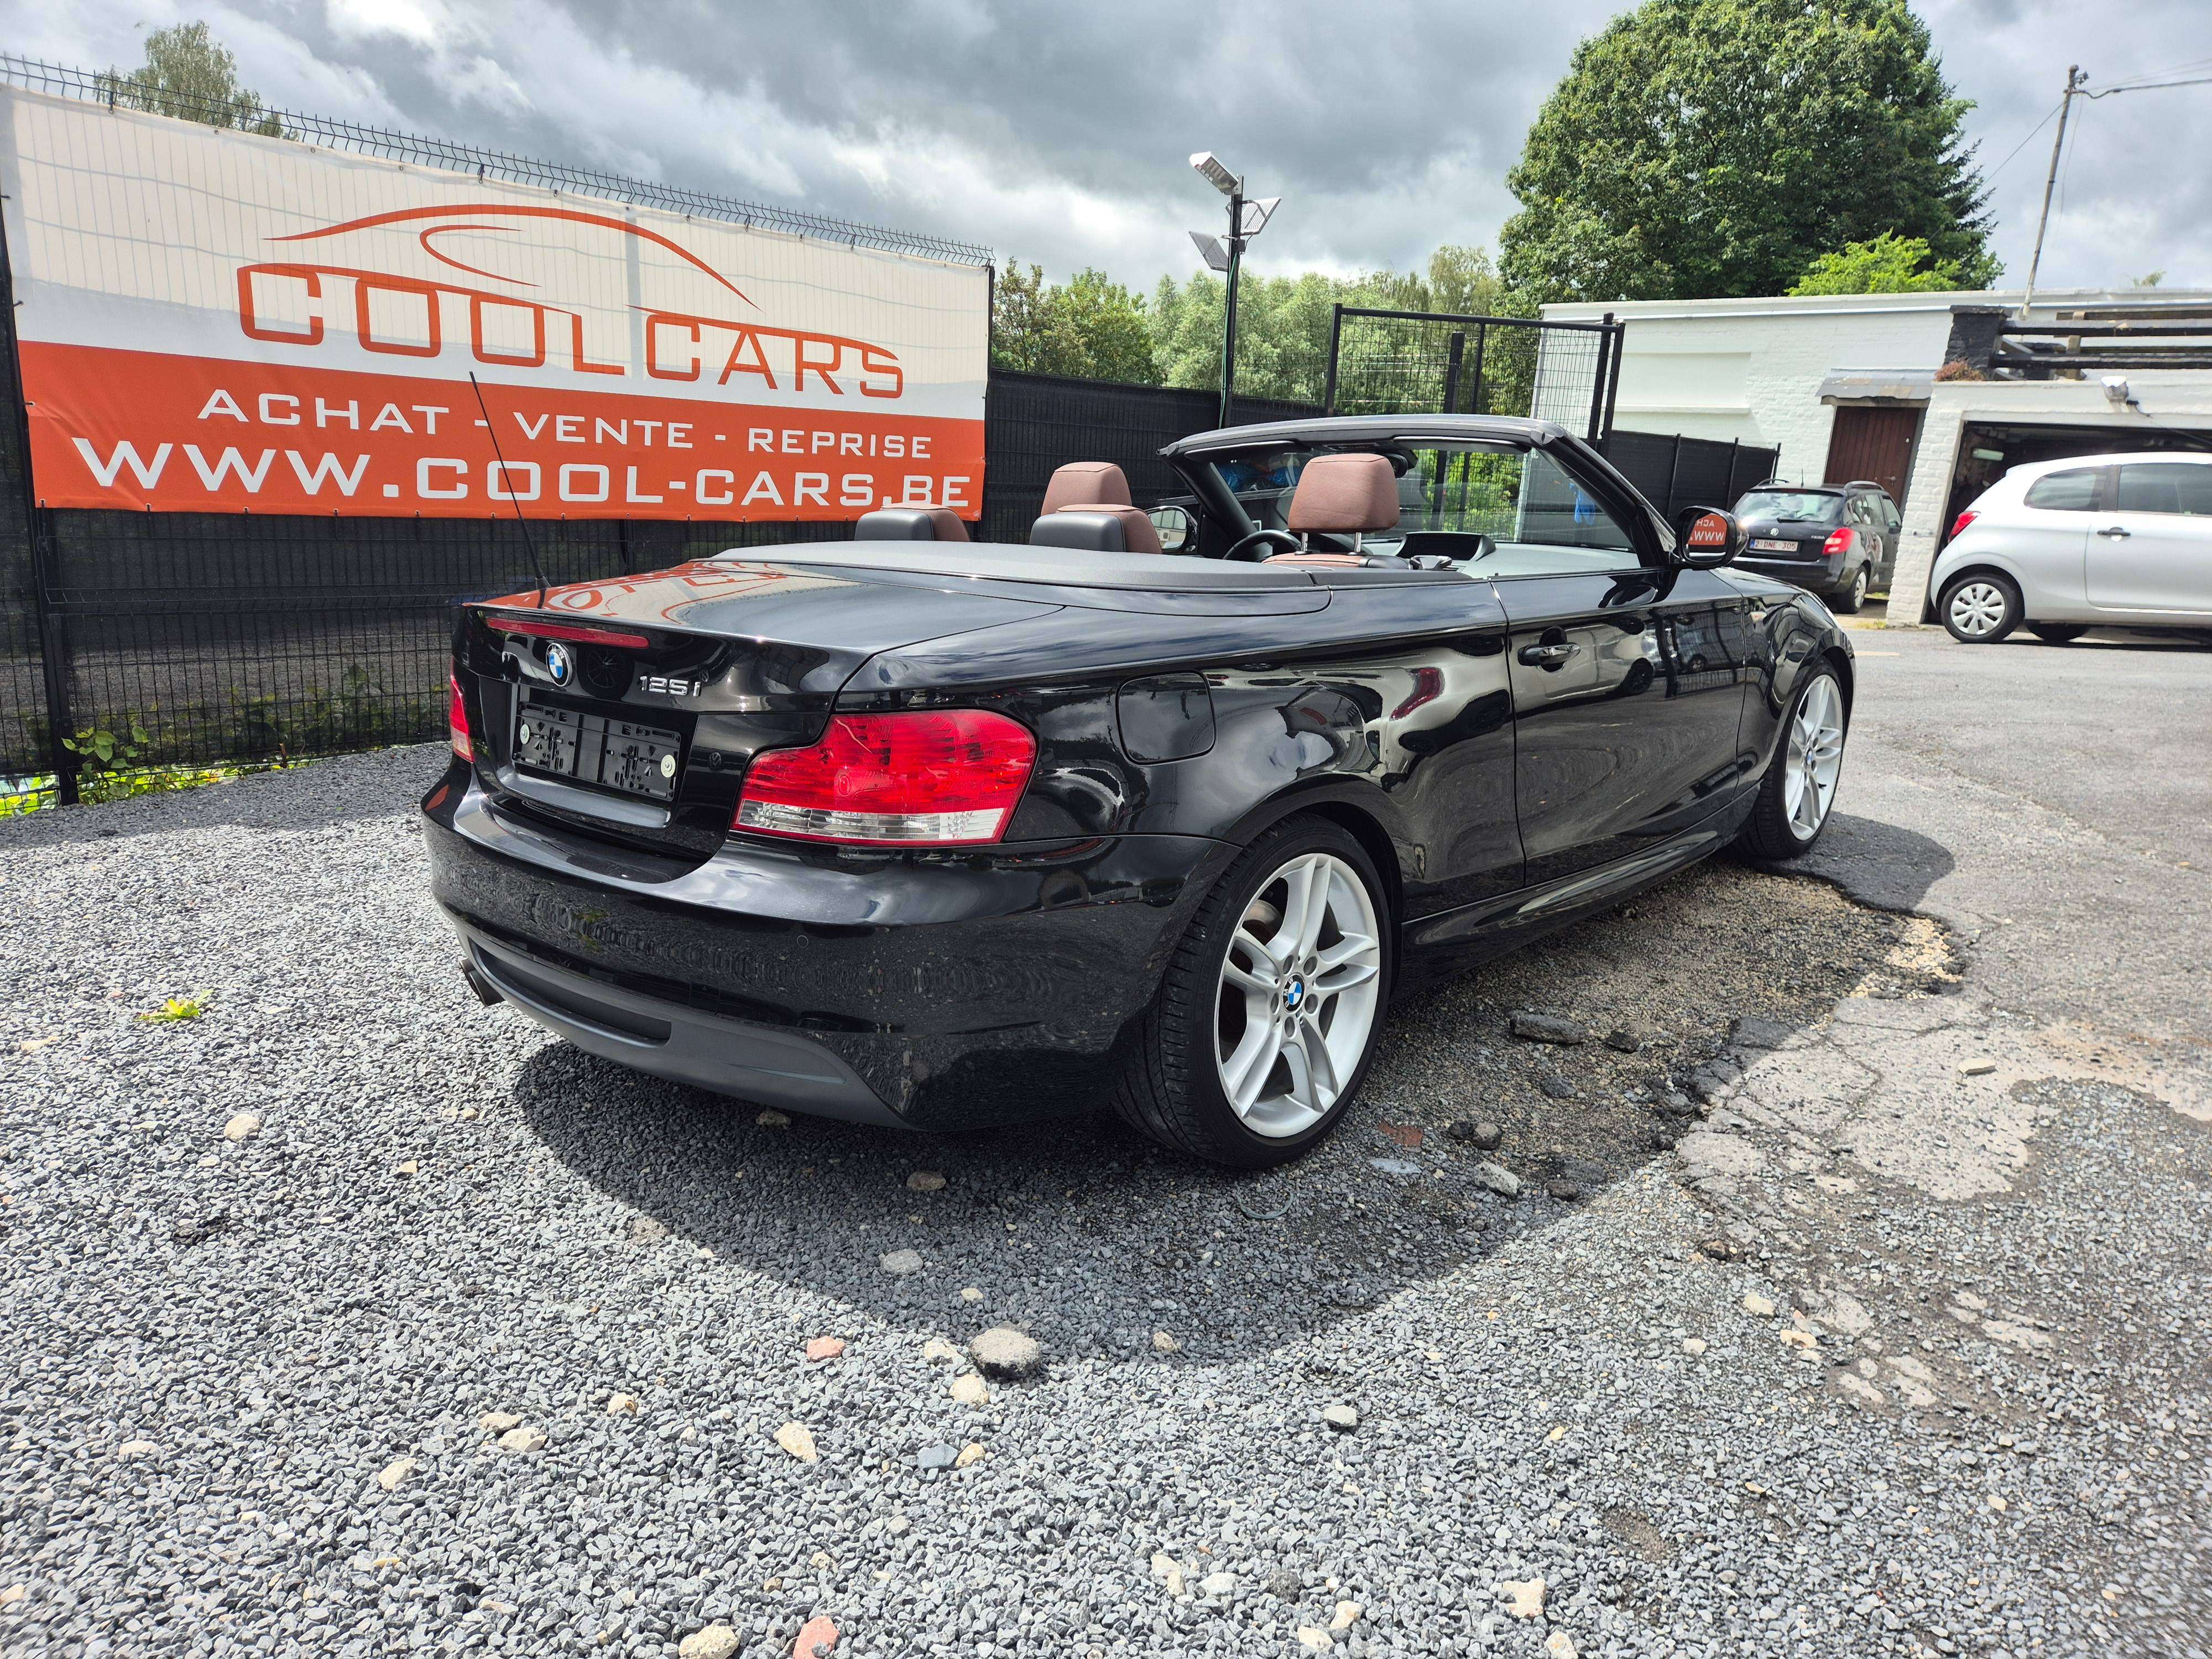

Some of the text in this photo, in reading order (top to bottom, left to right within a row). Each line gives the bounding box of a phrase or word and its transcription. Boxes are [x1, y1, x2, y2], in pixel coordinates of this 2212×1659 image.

[237, 263, 904, 399] COOL CARS
[197, 389, 449, 435] ACHAT
[513, 412, 693, 448] VENTE
[748, 427, 931, 458] REPRISE
[72, 437, 970, 507] WWW.COOL-CARS.BE
